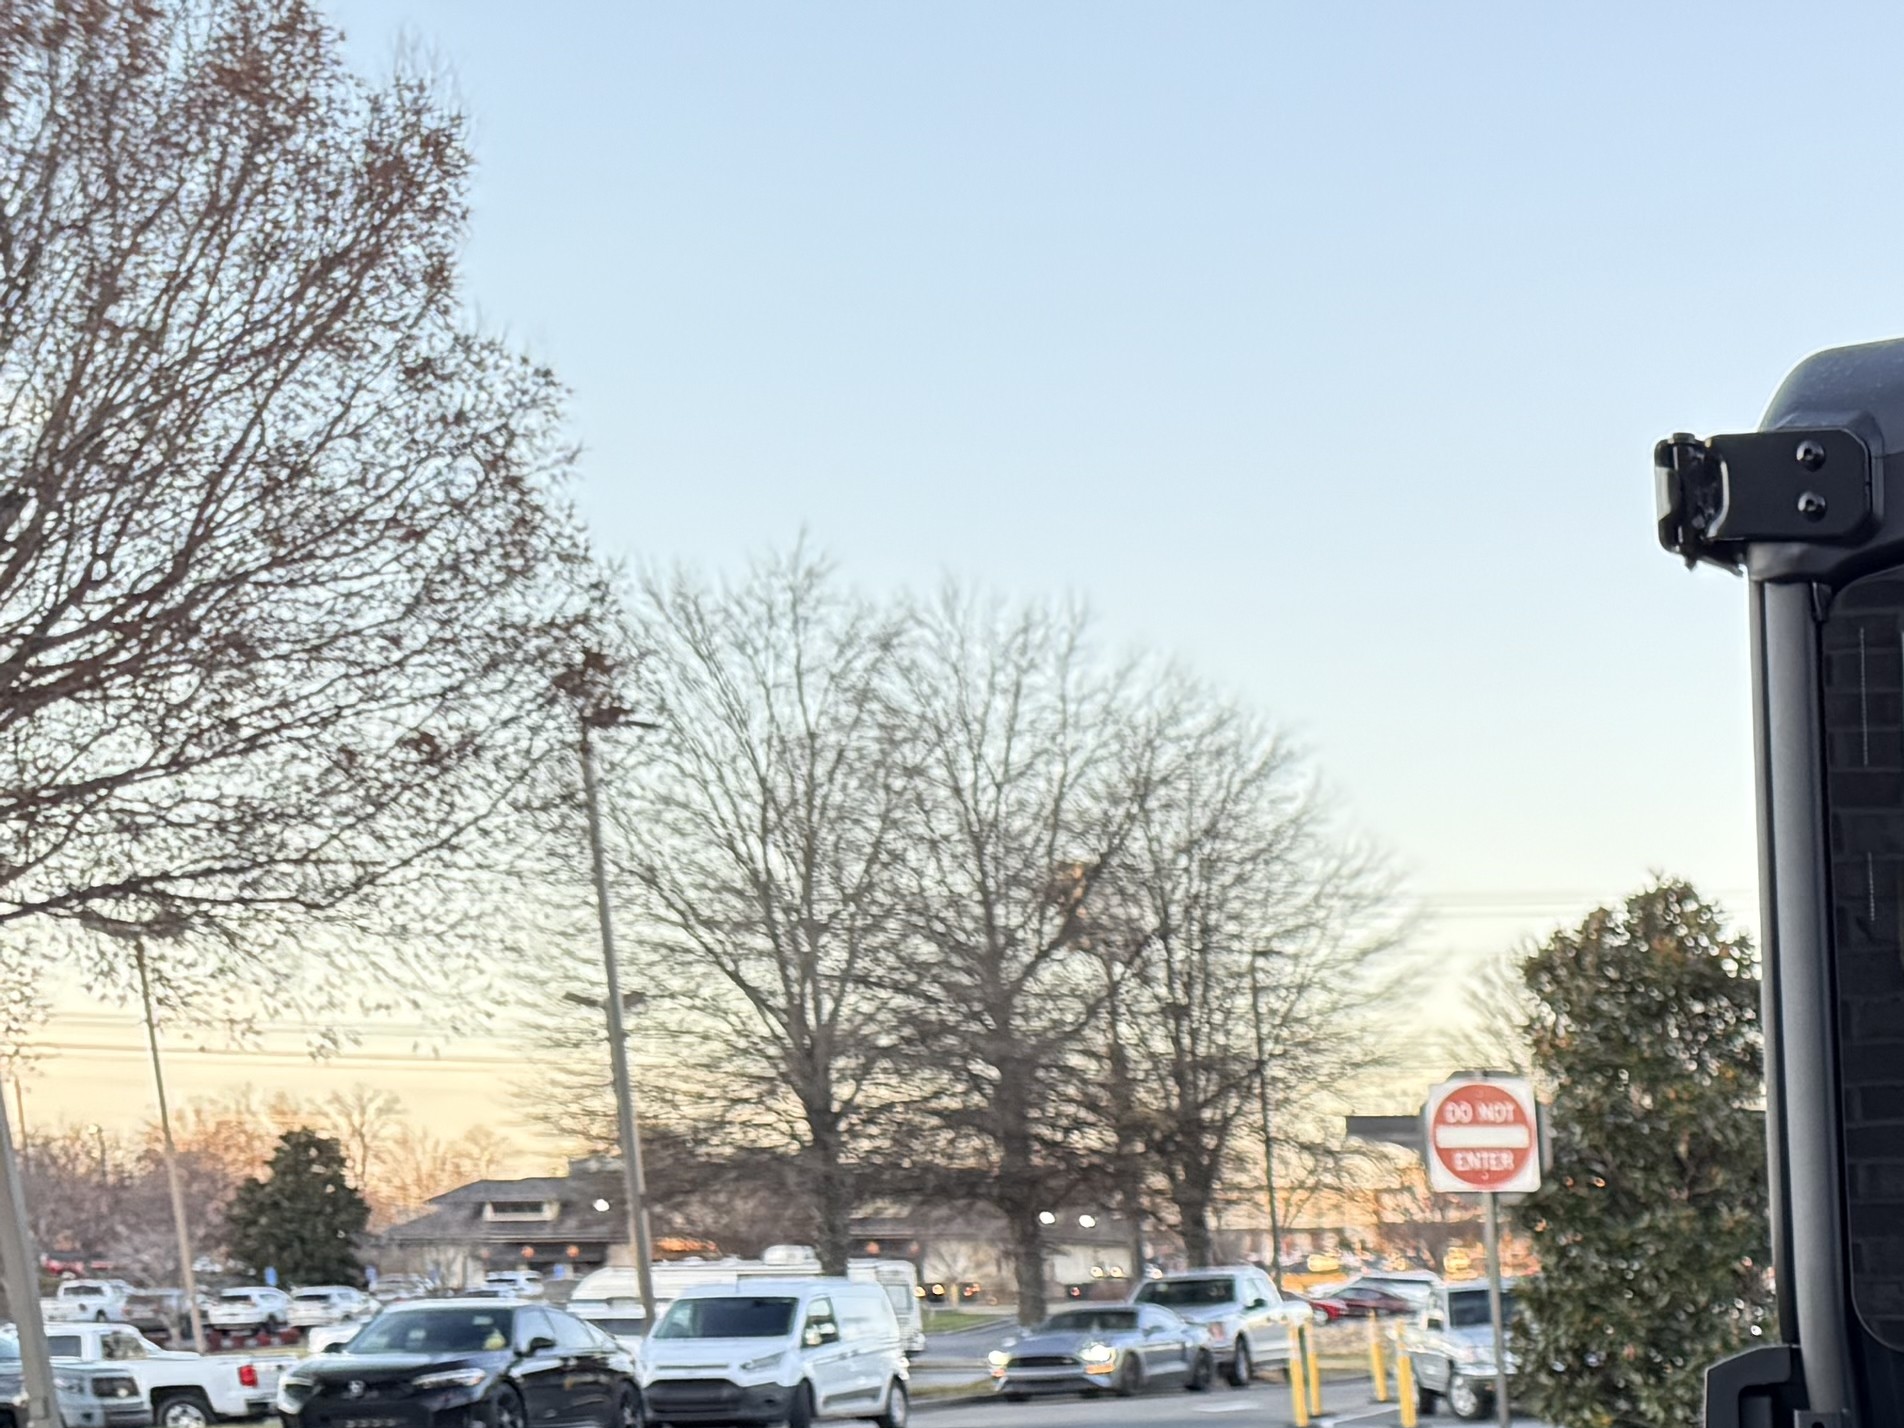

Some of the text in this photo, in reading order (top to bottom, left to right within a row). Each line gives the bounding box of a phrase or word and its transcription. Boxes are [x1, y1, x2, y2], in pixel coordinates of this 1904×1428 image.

[1444, 1101, 1515, 1124] DO NOT
[1452, 1149, 1515, 1171] ENTER
